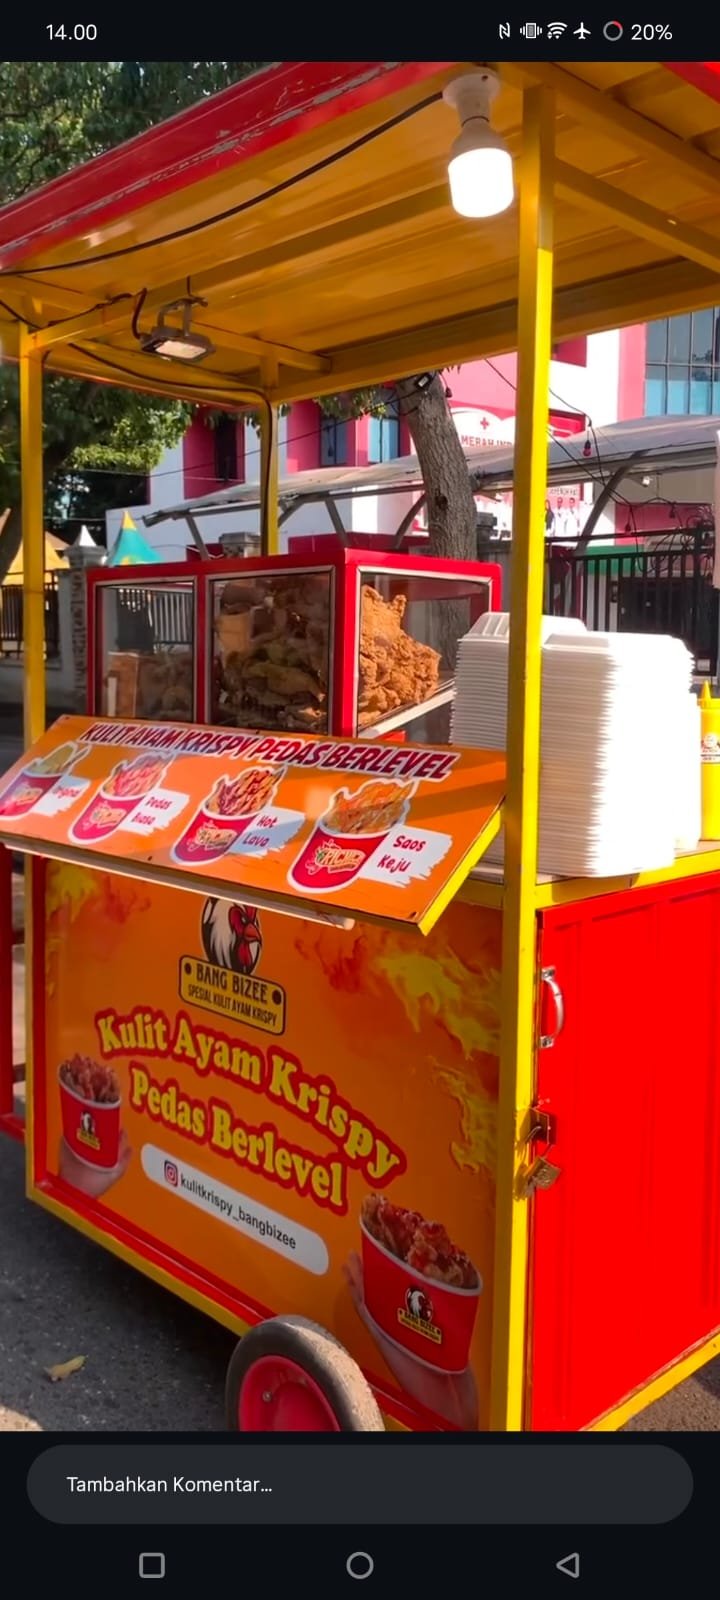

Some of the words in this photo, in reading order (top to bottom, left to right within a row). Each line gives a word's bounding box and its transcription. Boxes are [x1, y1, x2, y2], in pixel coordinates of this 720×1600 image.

[80, 724, 137, 743] KULIT
[126, 726, 183, 747] AYAM
[175, 731, 261, 757] KRISPY
[248, 737, 334, 766] PEDAS
[322, 745, 458, 779] BERLEVEL
[145, 796, 173, 810] Pedas
[256, 815, 279, 828] Hot
[242, 832, 270, 847] Lava
[393, 835, 427, 852] Saos
[377, 854, 412, 874] Keju
[196, 963, 228, 990] BANG
[232, 971, 269, 1004] BIZEE
[188, 984, 212, 1004] SPESIAL
[213, 991, 231, 1010] KULIT
[232, 1000, 253, 1018] AYAM
[252, 1006, 278, 1027] KRISPY
[96, 1013, 169, 1054] Kulit
[173, 1018, 262, 1086] Ayam
[269, 1052, 400, 1180] Krispy
[130, 1067, 206, 1137] Pedas
[211, 1104, 344, 1207] Berlevel
[180, 1172, 297, 1250] kulitkrispy_bangbizee
